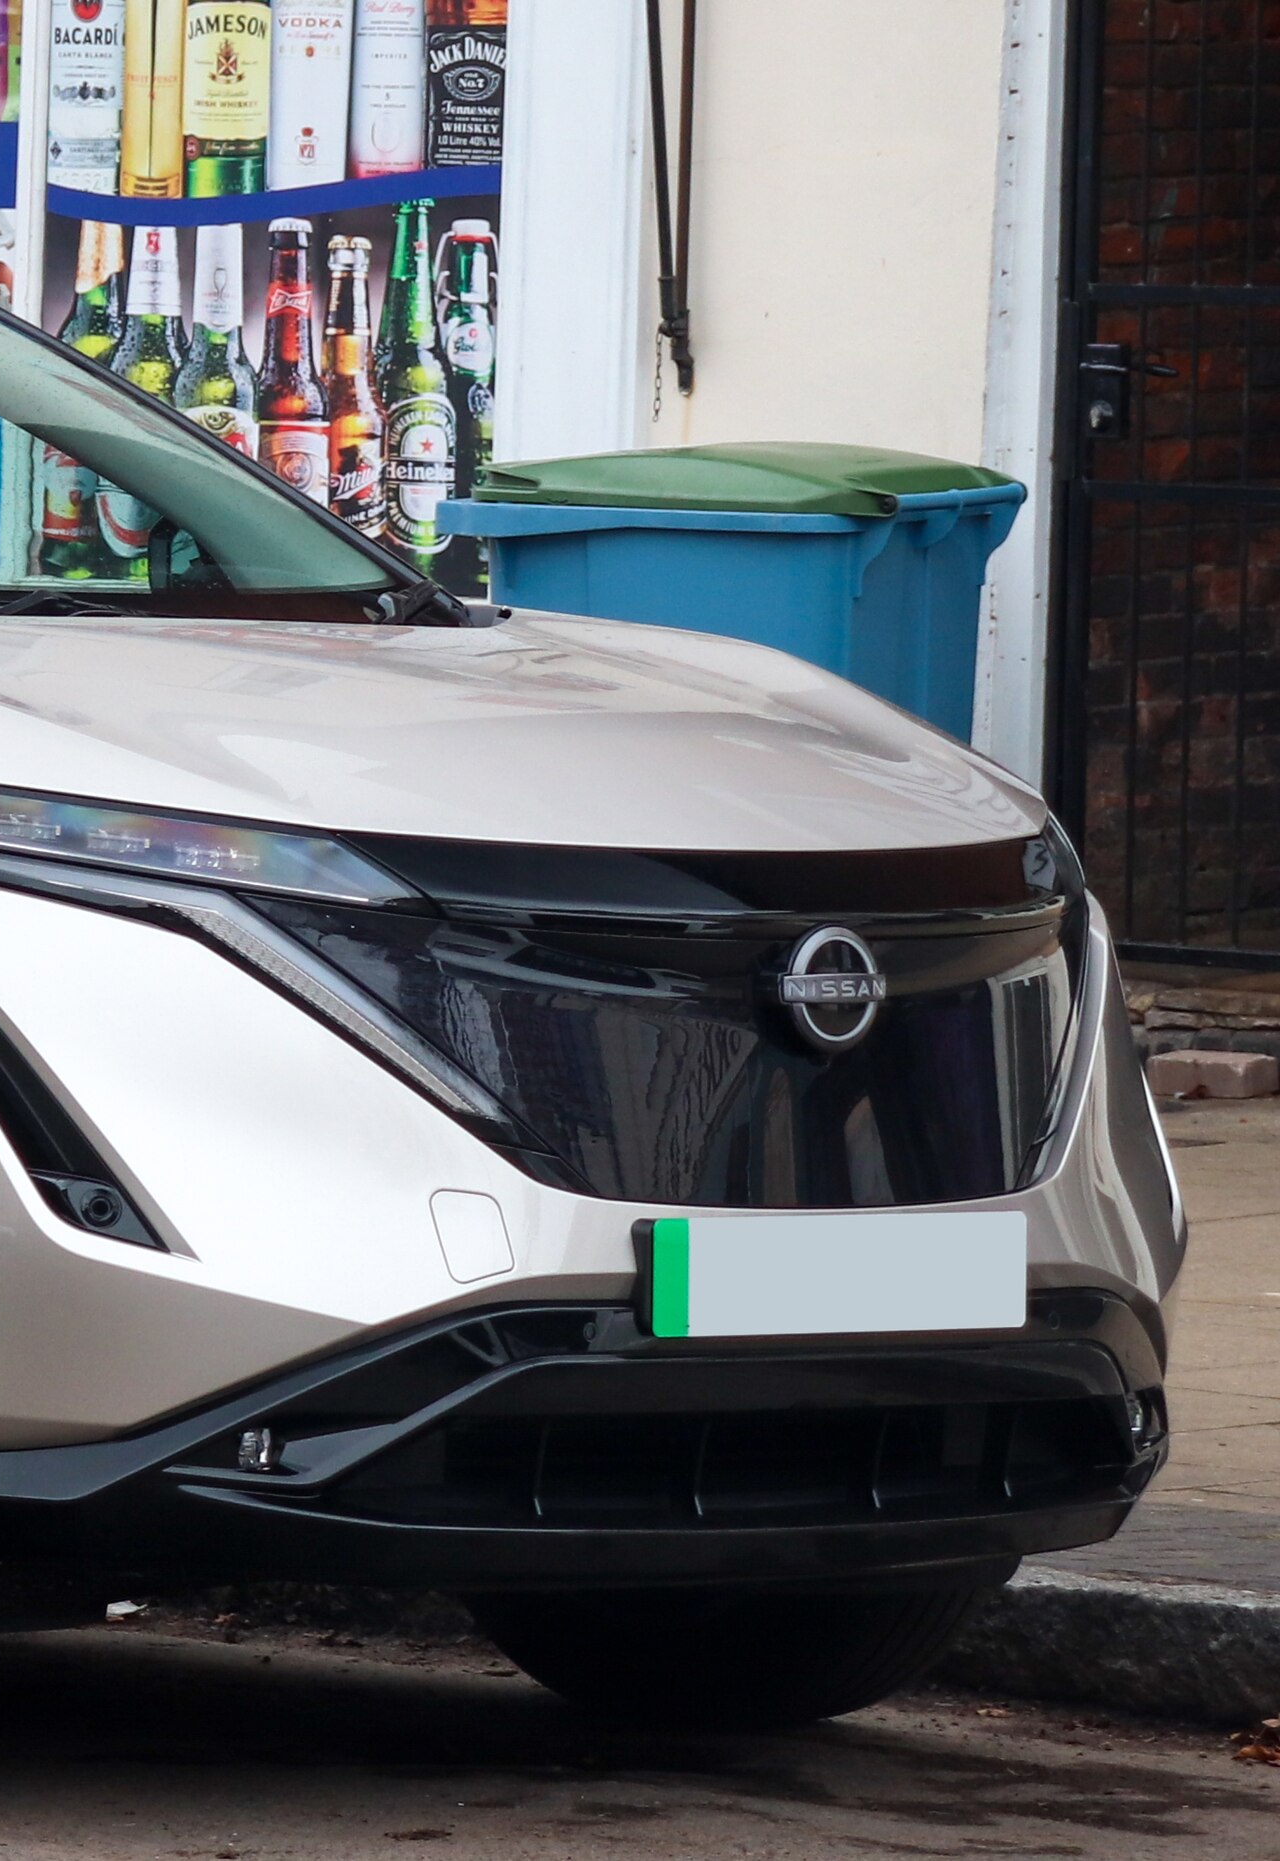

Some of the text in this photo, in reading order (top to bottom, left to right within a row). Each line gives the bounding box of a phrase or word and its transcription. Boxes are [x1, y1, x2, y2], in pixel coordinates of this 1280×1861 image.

[188, 14, 269, 40] JAMESON
[278, 18, 343, 28] VODKA
[54, 24, 119, 46] BACARDÍ
[429, 43, 464, 73] JACK
[458, 78, 486, 89] No.7
[441, 100, 501, 116] Tennessee
[441, 122, 500, 134] WHISKEY
[386, 460, 456, 481] Heineken
[785, 978, 886, 999] NISSAN
